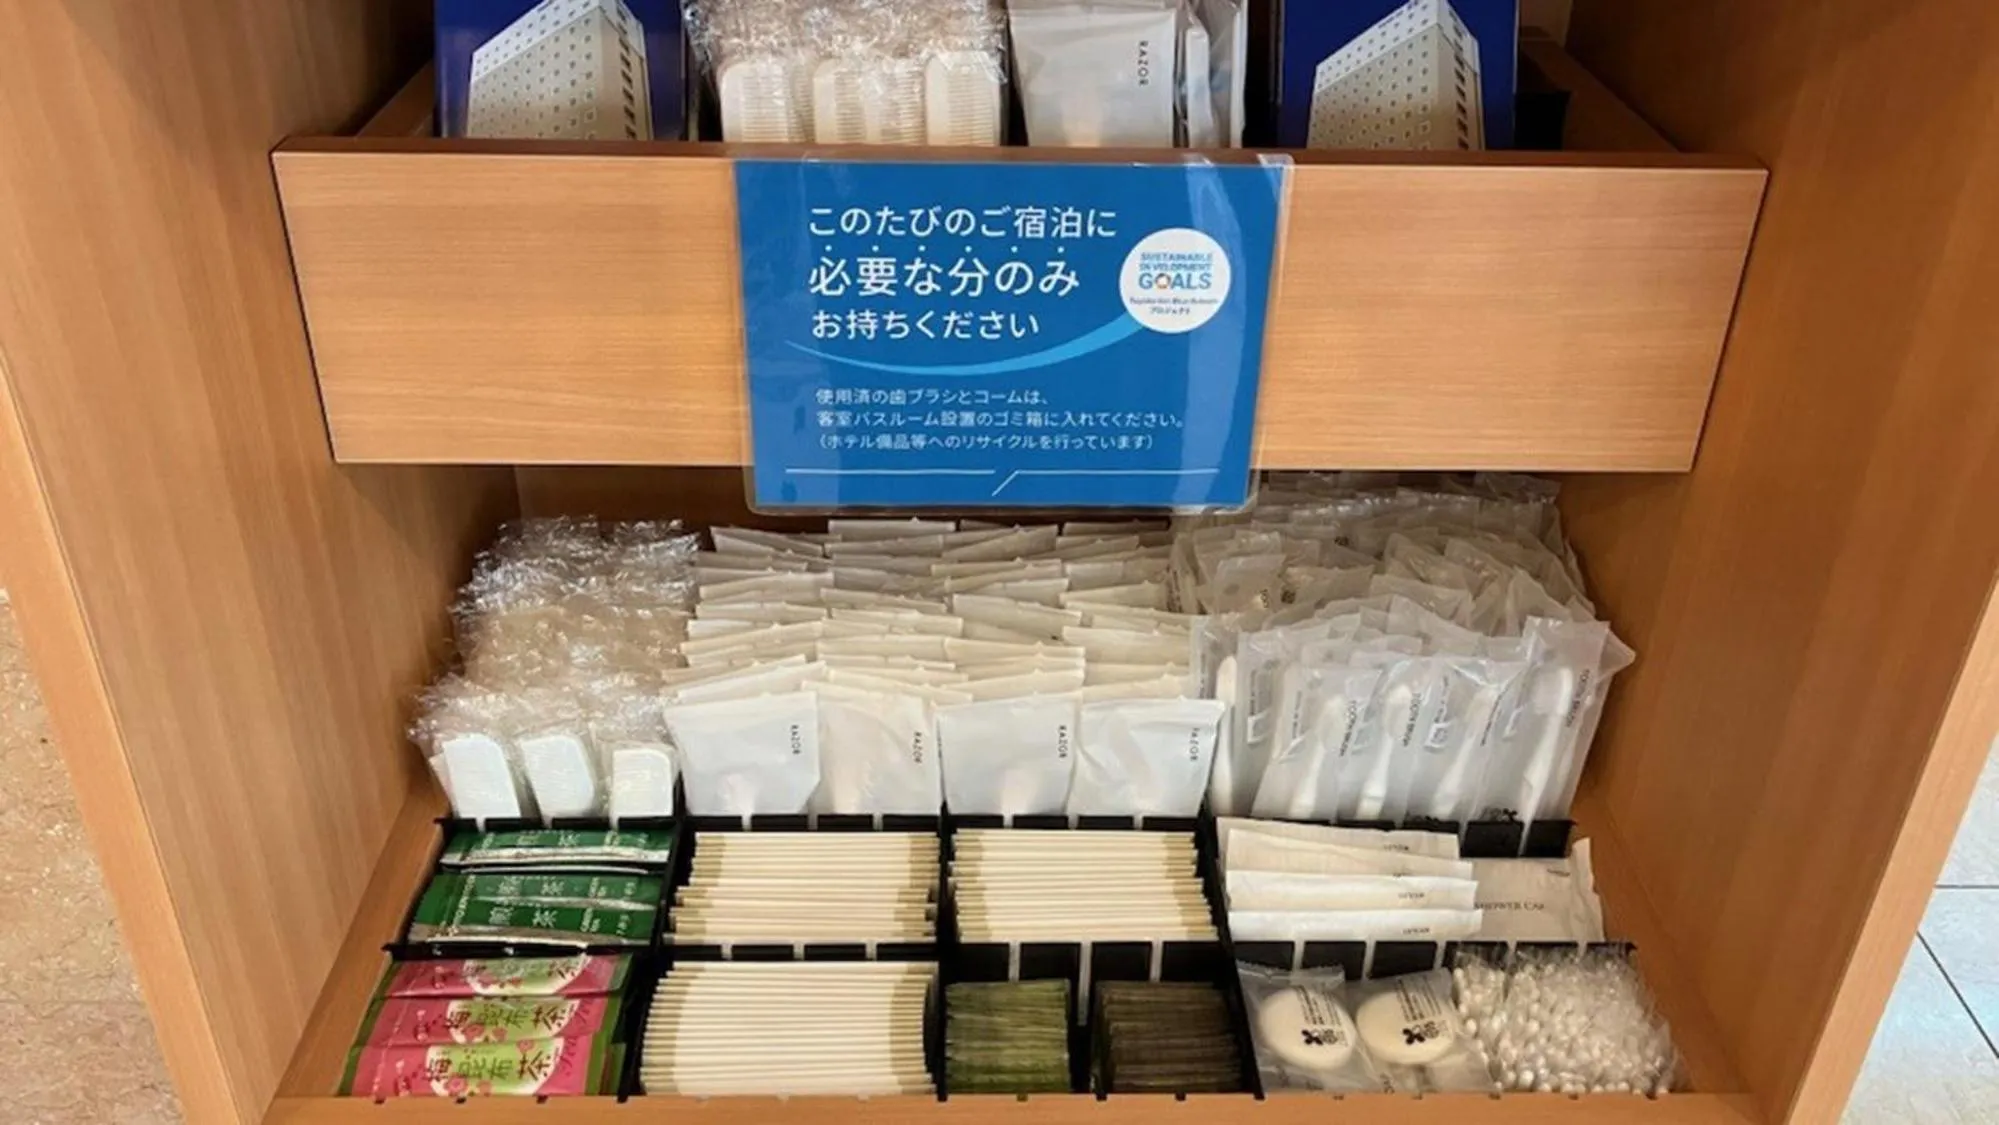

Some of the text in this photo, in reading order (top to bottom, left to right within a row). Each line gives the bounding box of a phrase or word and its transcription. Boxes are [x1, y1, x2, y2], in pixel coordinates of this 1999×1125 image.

[1138, 40, 1149, 86] RAZOR
[809, 205, 1118, 239] このたびのご宿泊に
[808, 256, 1080, 297] 必要な分のみ
[1138, 273, 1212, 290] GOALS
[811, 309, 1040, 340] お持ちください
[815, 388, 1050, 406] 使用済の歯ブラシとコームは、
[816, 411, 1184, 429] 客室バスルーム設置のゴミ箱に入れてください。
[791, 724, 801, 755] RAZOR
[912, 731, 923, 764] RAZOR
[1058, 724, 1068, 759] RAZOR
[1190, 727, 1200, 761] RAZOR
[424, 1050, 551, 1082] 梅昆布茶
